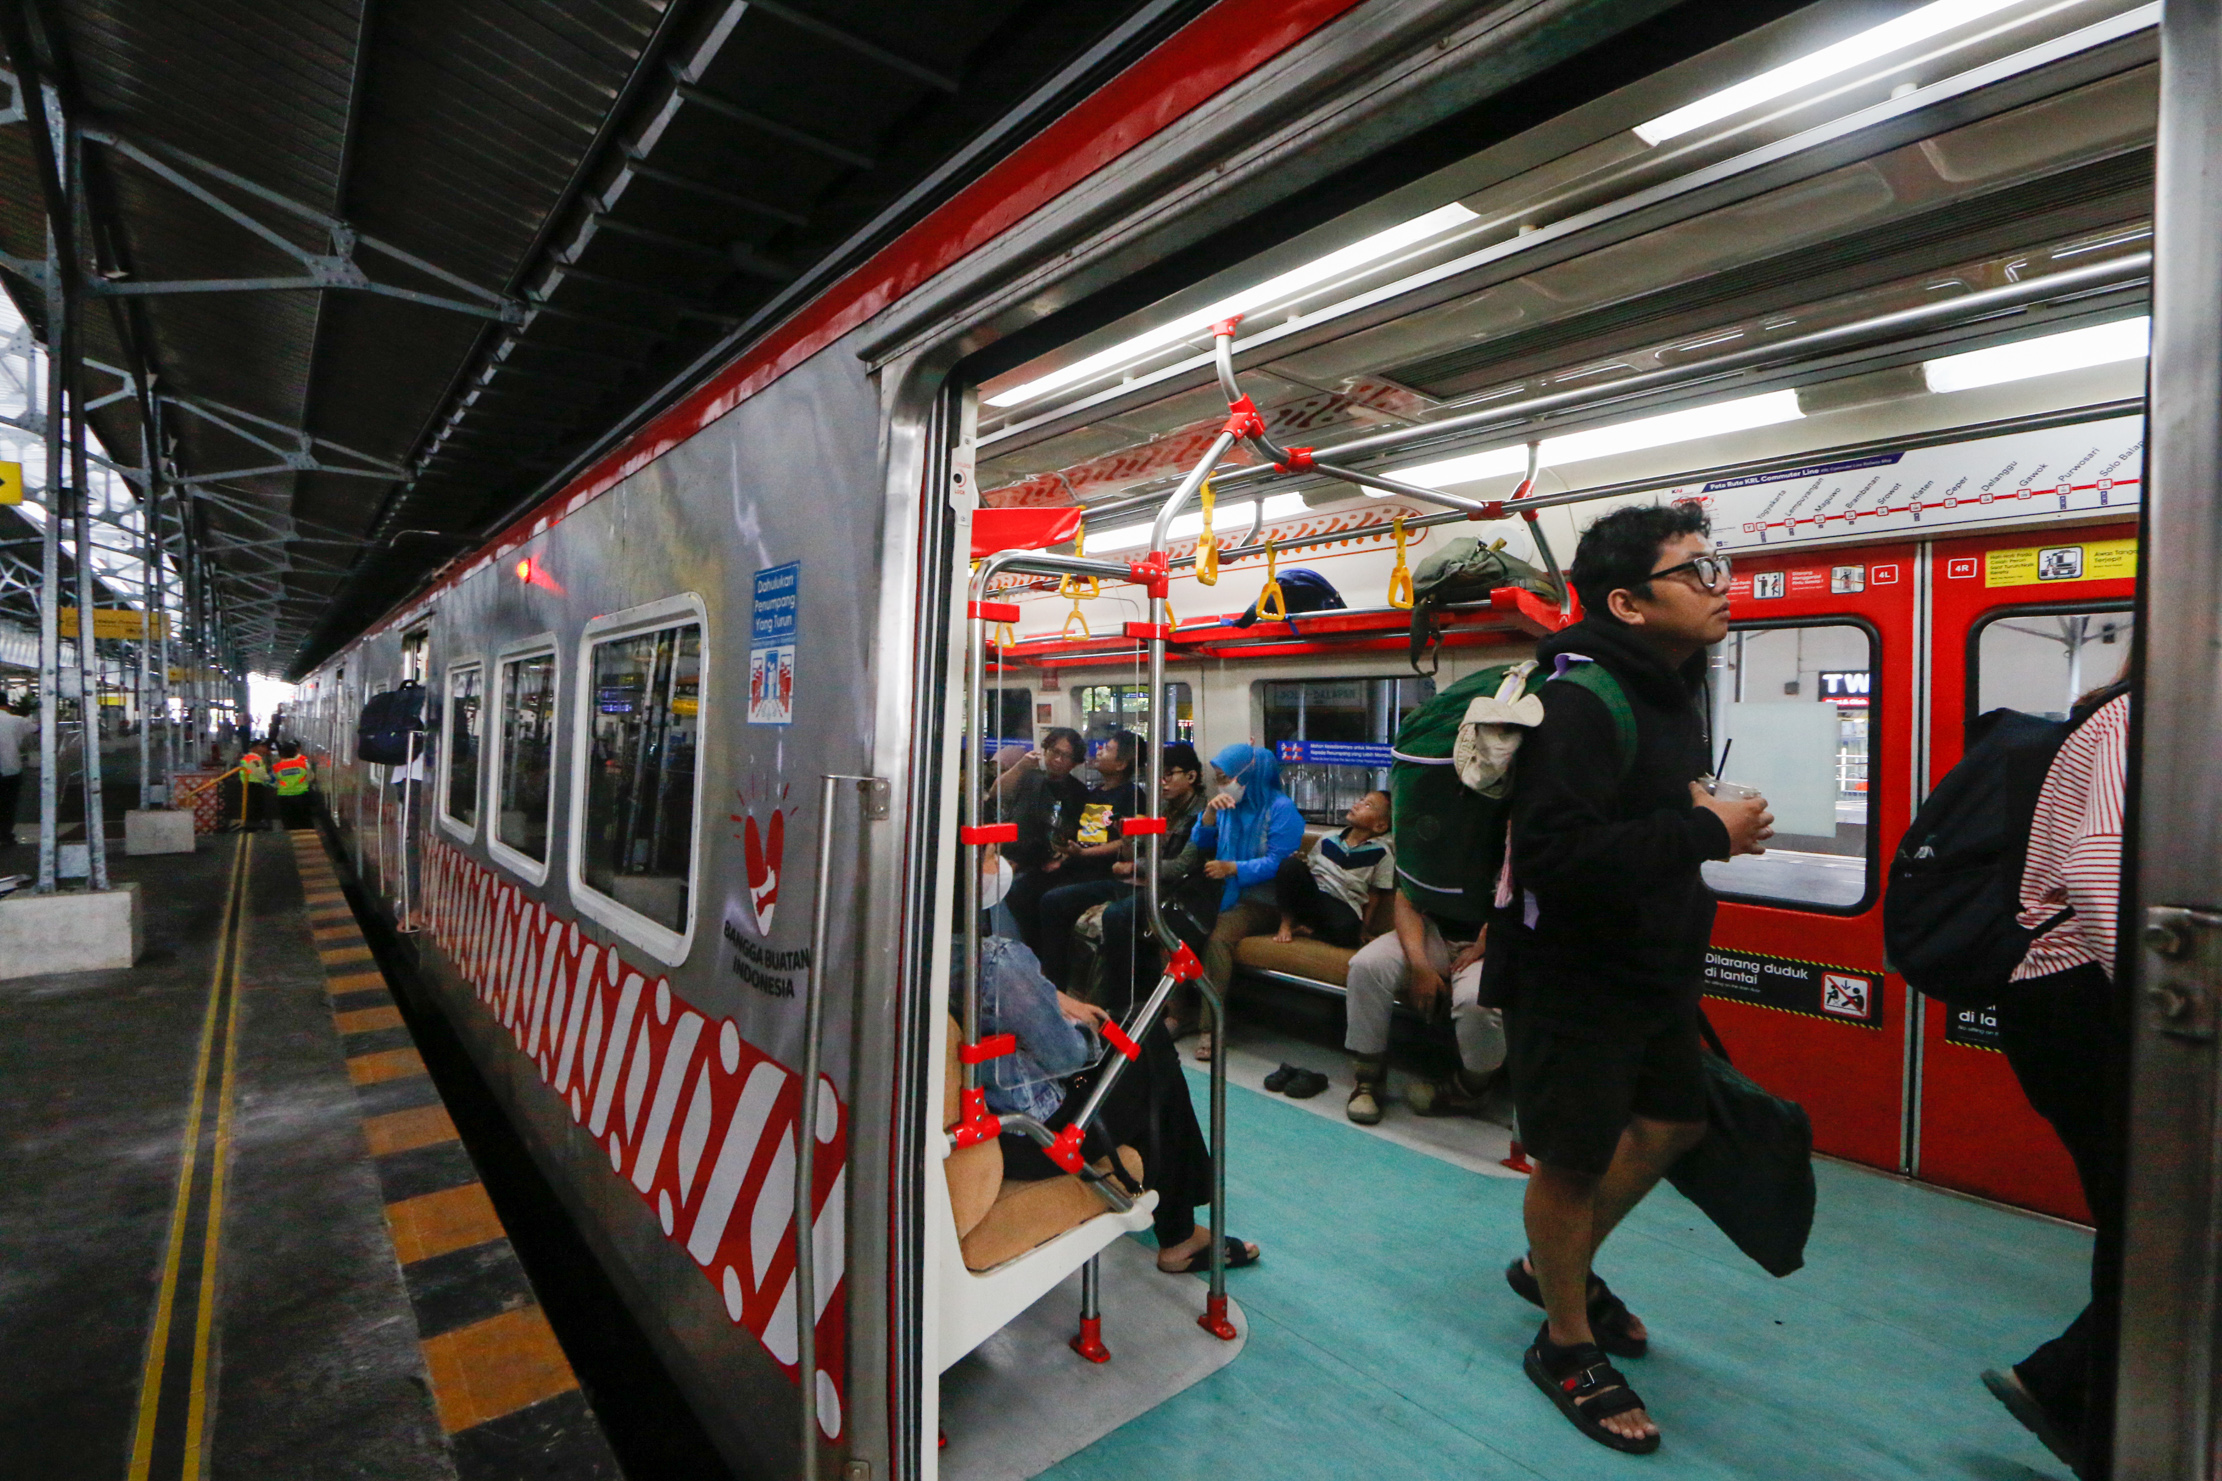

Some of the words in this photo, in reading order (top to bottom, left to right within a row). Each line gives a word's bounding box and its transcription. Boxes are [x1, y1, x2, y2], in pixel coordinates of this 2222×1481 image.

[2019, 462, 2048, 488] Gawok
[2058, 446, 2101, 482] Purwosari
[2100, 459, 2122, 477] Solo
[1710, 482, 1726, 490] Peta
[1727, 480, 1744, 488] Rute
[1744, 476, 1760, 486] KRL
[1760, 470, 1801, 482] Commuter
[1802, 468, 1820, 476] Line
[1945, 475, 1969, 497] Ceper
[1980, 460, 2018, 492] Delanggu
[1784, 477, 1824, 517] Lempuyangan
[1814, 486, 1842, 513] Maguwo
[1846, 475, 1881, 509] Brambanan
[1877, 482, 1902, 505] Srowot
[1910, 479, 1934, 501] Klaten
[1756, 489, 1787, 520] Yogyakarta
[1955, 564, 1970, 572] 4R
[758, 575, 794, 594] Dahulukan
[754, 594, 796, 612] Penumpang
[756, 617, 773, 632] Yang
[774, 614, 792, 628] Turun
[724, 920, 763, 966] BANGGA
[764, 948, 812, 971] BUATAN
[733, 955, 794, 998] INDONESIA
[1705, 953, 1760, 973] Dilarang
[1764, 963, 1808, 980] duduk
[1705, 967, 1717, 978] di
[1720, 969, 1758, 985] lantai
[1958, 1010, 1975, 1023] di
